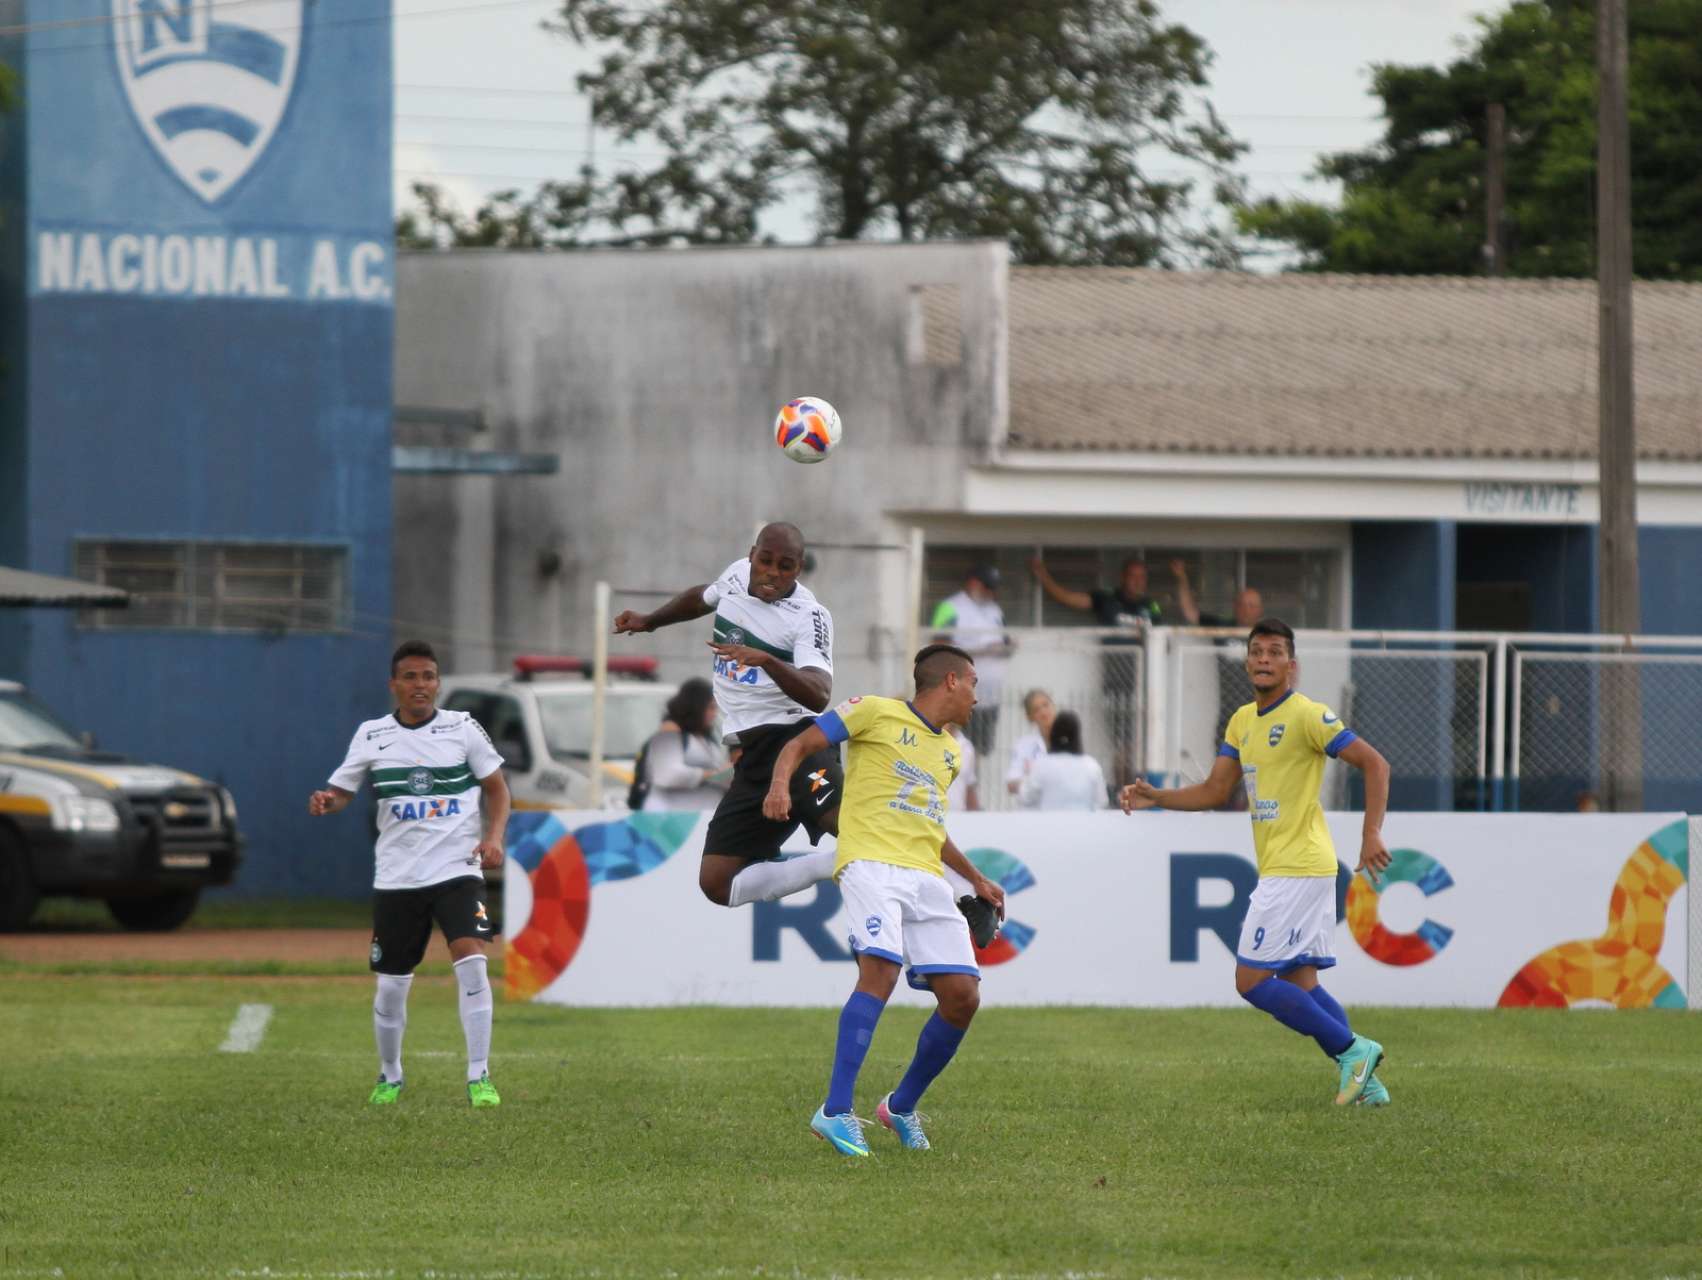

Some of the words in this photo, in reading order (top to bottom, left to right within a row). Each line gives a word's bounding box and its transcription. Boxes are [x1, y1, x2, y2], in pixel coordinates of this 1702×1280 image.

[38, 231, 290, 297] NACIONAL
[307, 239, 393, 299] A.C.
[1464, 481, 1582, 514] VISITANTE
[1252, 926, 1266, 951] 9
